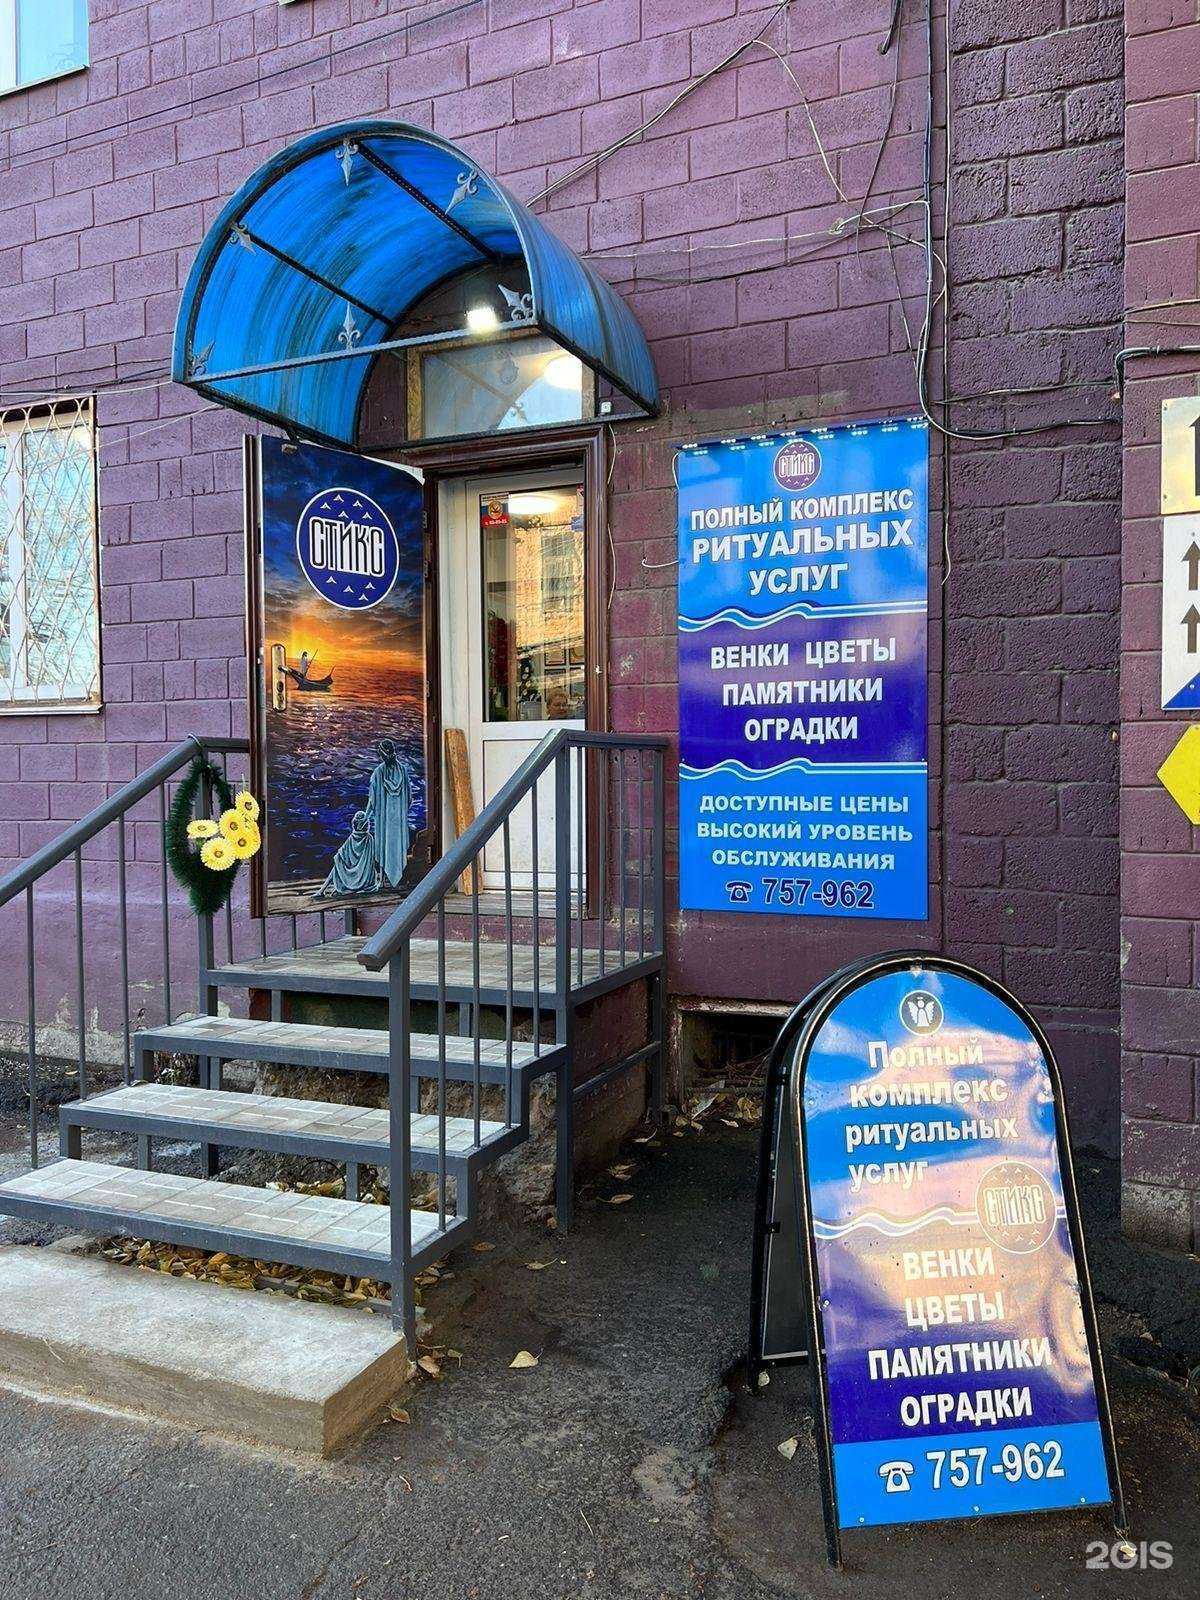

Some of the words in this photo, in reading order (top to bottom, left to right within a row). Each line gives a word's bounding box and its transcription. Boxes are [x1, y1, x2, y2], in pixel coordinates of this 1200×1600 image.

[691, 498, 783, 531] ПОЛНЫЙ
[790, 489, 914, 520] КОМПЛЕКС
[309, 516, 386, 578] СТИКС
[692, 519, 914, 563] РИТУАЛЬНЫХ
[749, 563, 848, 596] УСЛУГ
[711, 643, 789, 669] ВЕНКИ
[805, 638, 896, 668] ЦВЕТЫ
[722, 678, 883, 706] ПАМЯТНИКИ
[744, 717, 858, 745] ОГРАДКИ
[699, 796, 833, 814] ДОСТУПНЫЕ
[840, 796, 909, 815] ЦЕНЫ
[697, 820, 801, 840] ВЫСОКИЙ
[808, 824, 913, 842] УРОВЕНЬ
[712, 849, 895, 870] ОБСЛУЖИВАНИЯ
[762, 878, 874, 909] 757-962
[867, 1038, 984, 1069] Полный
[849, 1077, 1009, 1108] комплекс
[845, 1116, 1019, 1153] ритуальных
[848, 1160, 929, 1193] услуг
[983, 1185, 1046, 1227] СТИКС
[902, 1247, 996, 1281] ВЕНКИ
[905, 1292, 1005, 1332] ЦВЕТЫ
[868, 1337, 1053, 1381] ПАМЯТНИКИ
[900, 1386, 1033, 1427] ОГРАДКИ
[926, 1440, 1065, 1489] 757-962
